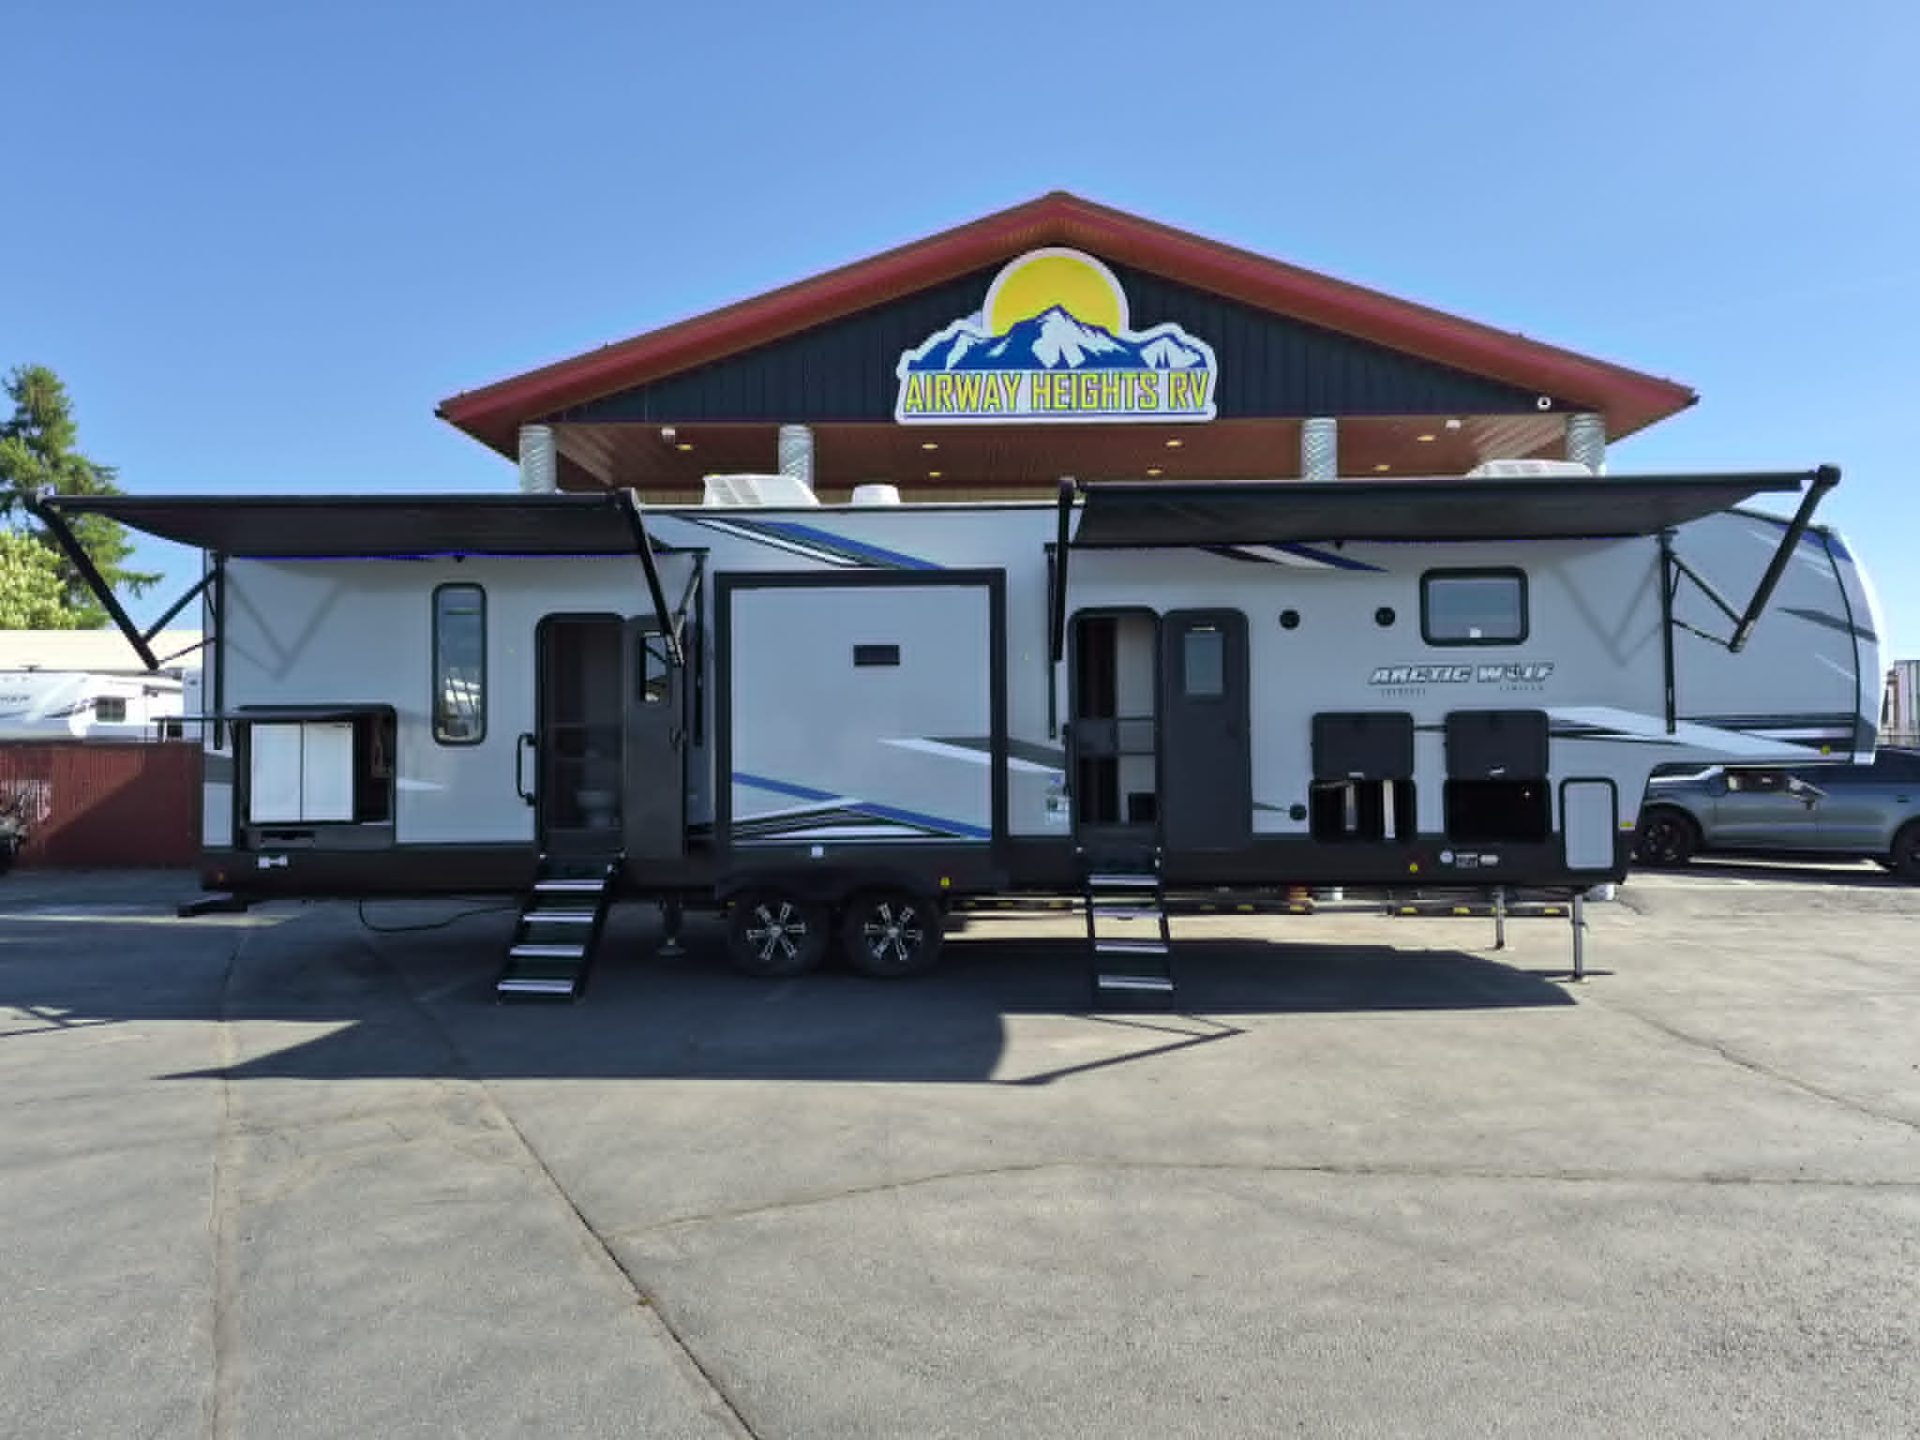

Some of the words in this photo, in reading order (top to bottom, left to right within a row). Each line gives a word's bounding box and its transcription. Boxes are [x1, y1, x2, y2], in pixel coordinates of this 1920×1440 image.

[904, 372, 1022, 412] AIRWAY
[1031, 372, 1160, 411] HEIGHTS
[1168, 371, 1210, 410] RV
[1368, 664, 1472, 685] ARCTIC
